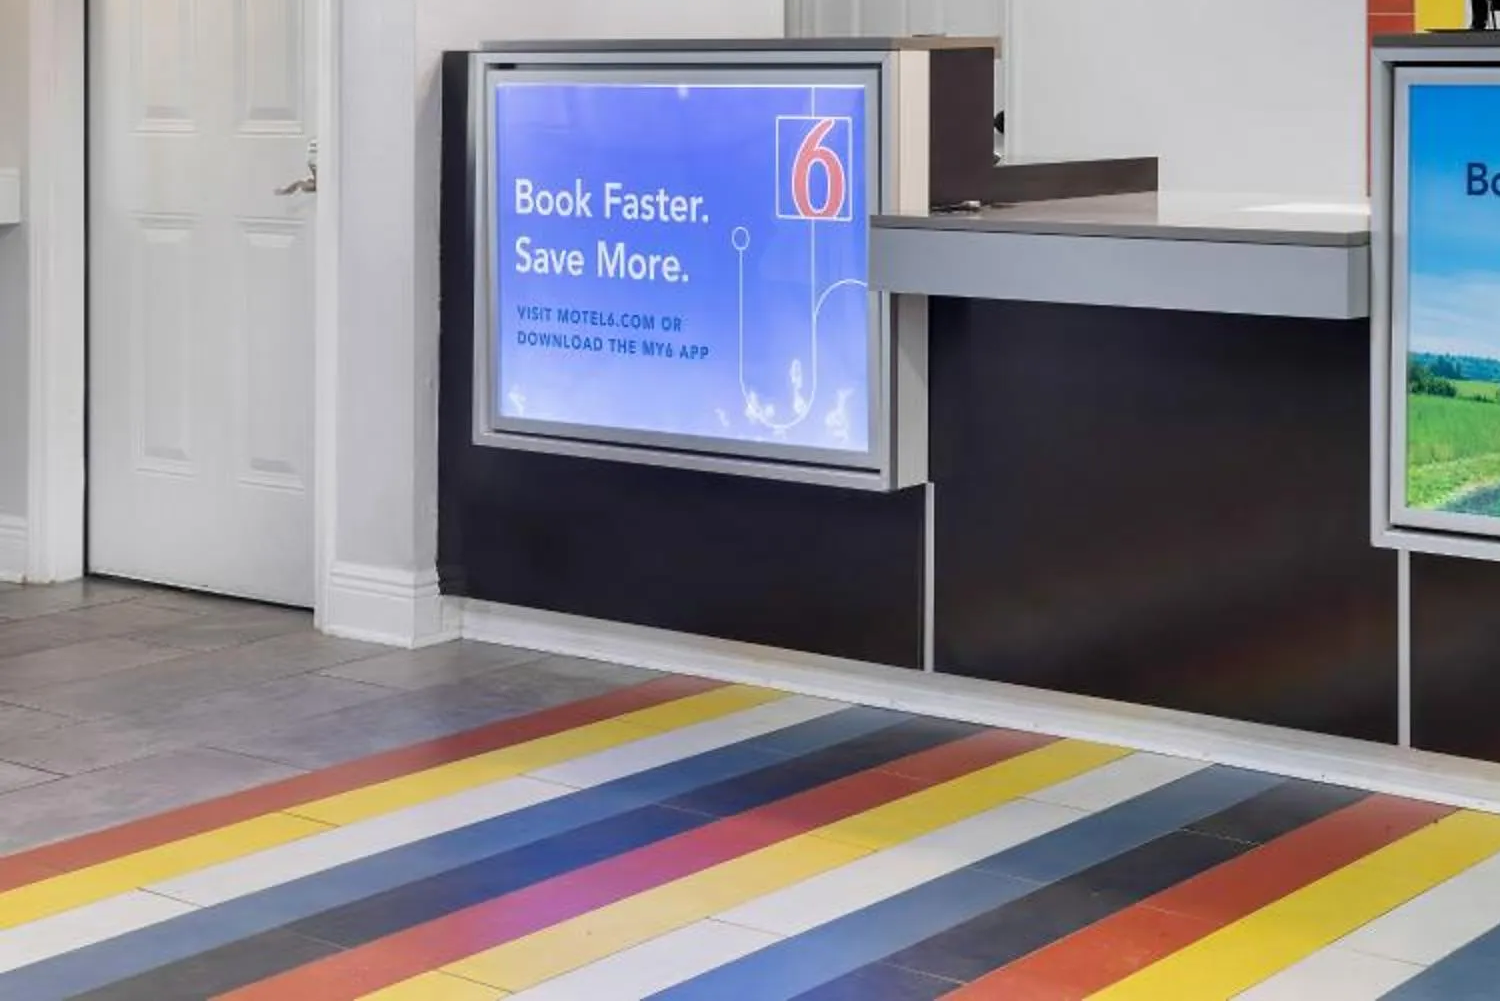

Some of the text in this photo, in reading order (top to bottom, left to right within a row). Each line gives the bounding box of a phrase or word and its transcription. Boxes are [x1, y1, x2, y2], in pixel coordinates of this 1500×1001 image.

[791, 117, 847, 219] 6
[514, 178, 710, 224] Book Faster.
[514, 235, 690, 283] Save More.
[517, 305, 683, 333] VISIT MOTEL6.COM OR
[517, 330, 710, 361] DOWNLOAD THE MY6 APP
